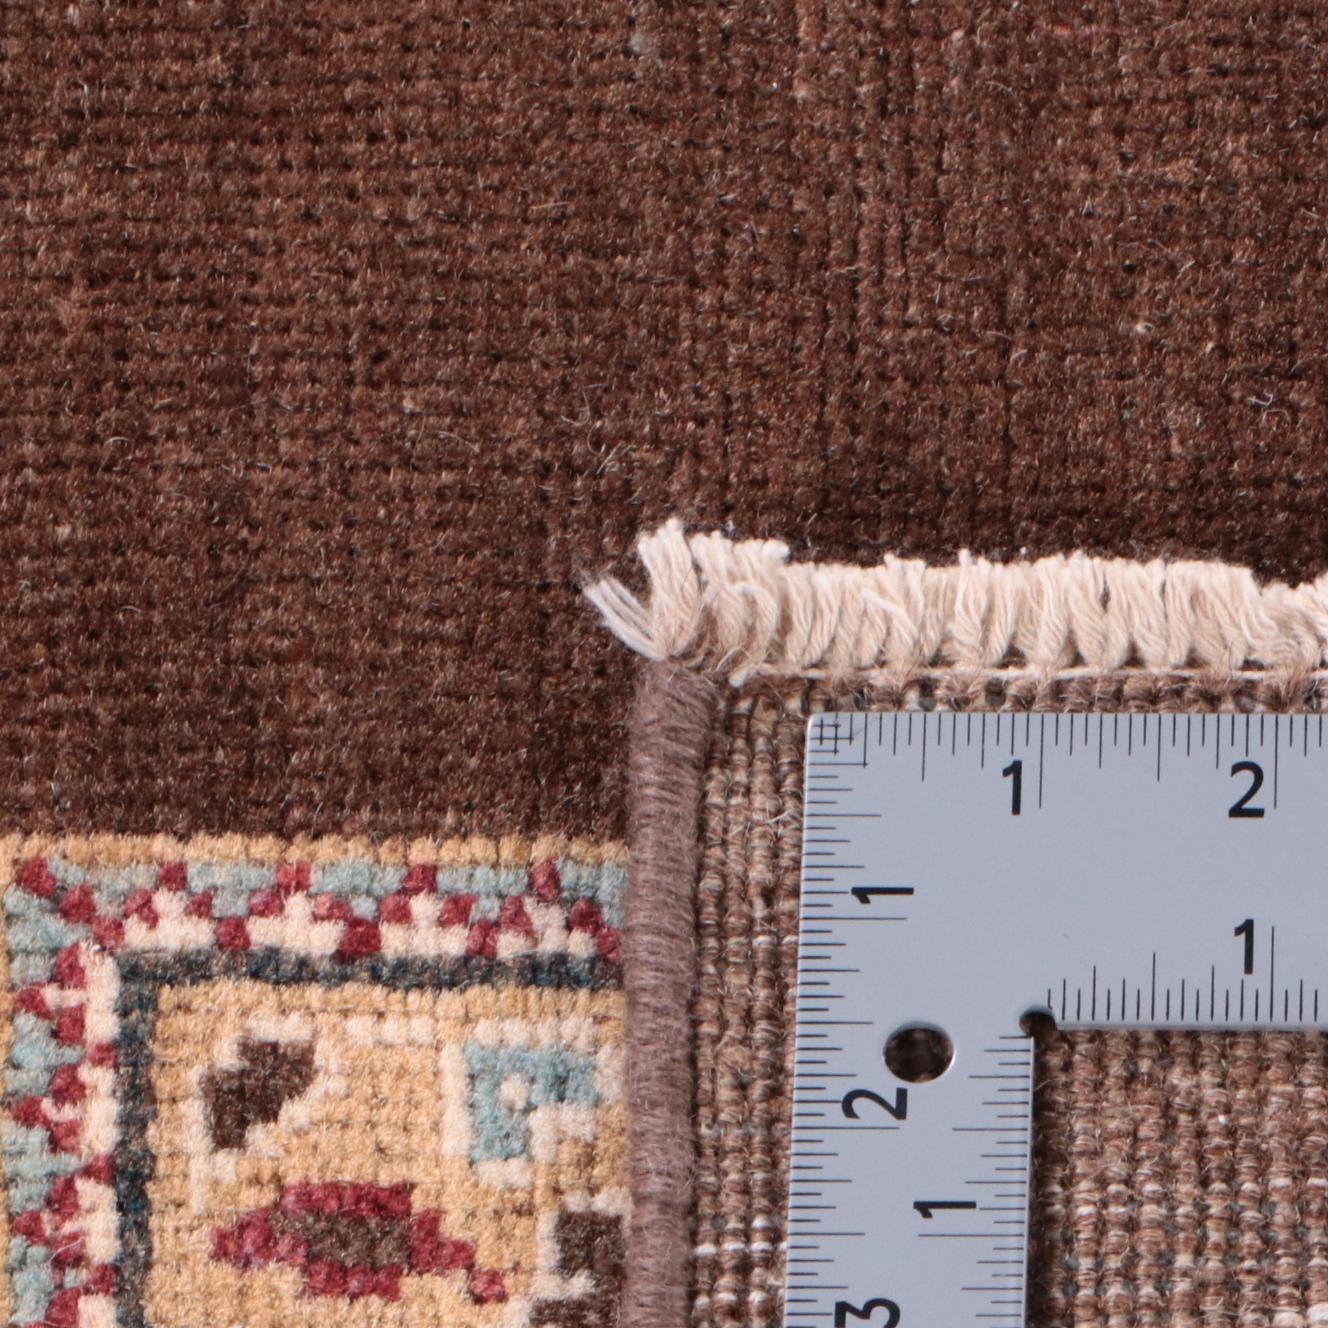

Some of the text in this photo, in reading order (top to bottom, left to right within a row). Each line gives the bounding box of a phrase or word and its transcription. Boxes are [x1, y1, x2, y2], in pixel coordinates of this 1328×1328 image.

[1001, 759, 1024, 817] 1
[1227, 759, 1266, 819] 2
[849, 885, 916, 906] 1
[1233, 917, 1255, 976] 1
[840, 1086, 909, 1122] 2
[912, 1199, 978, 1220] 1
